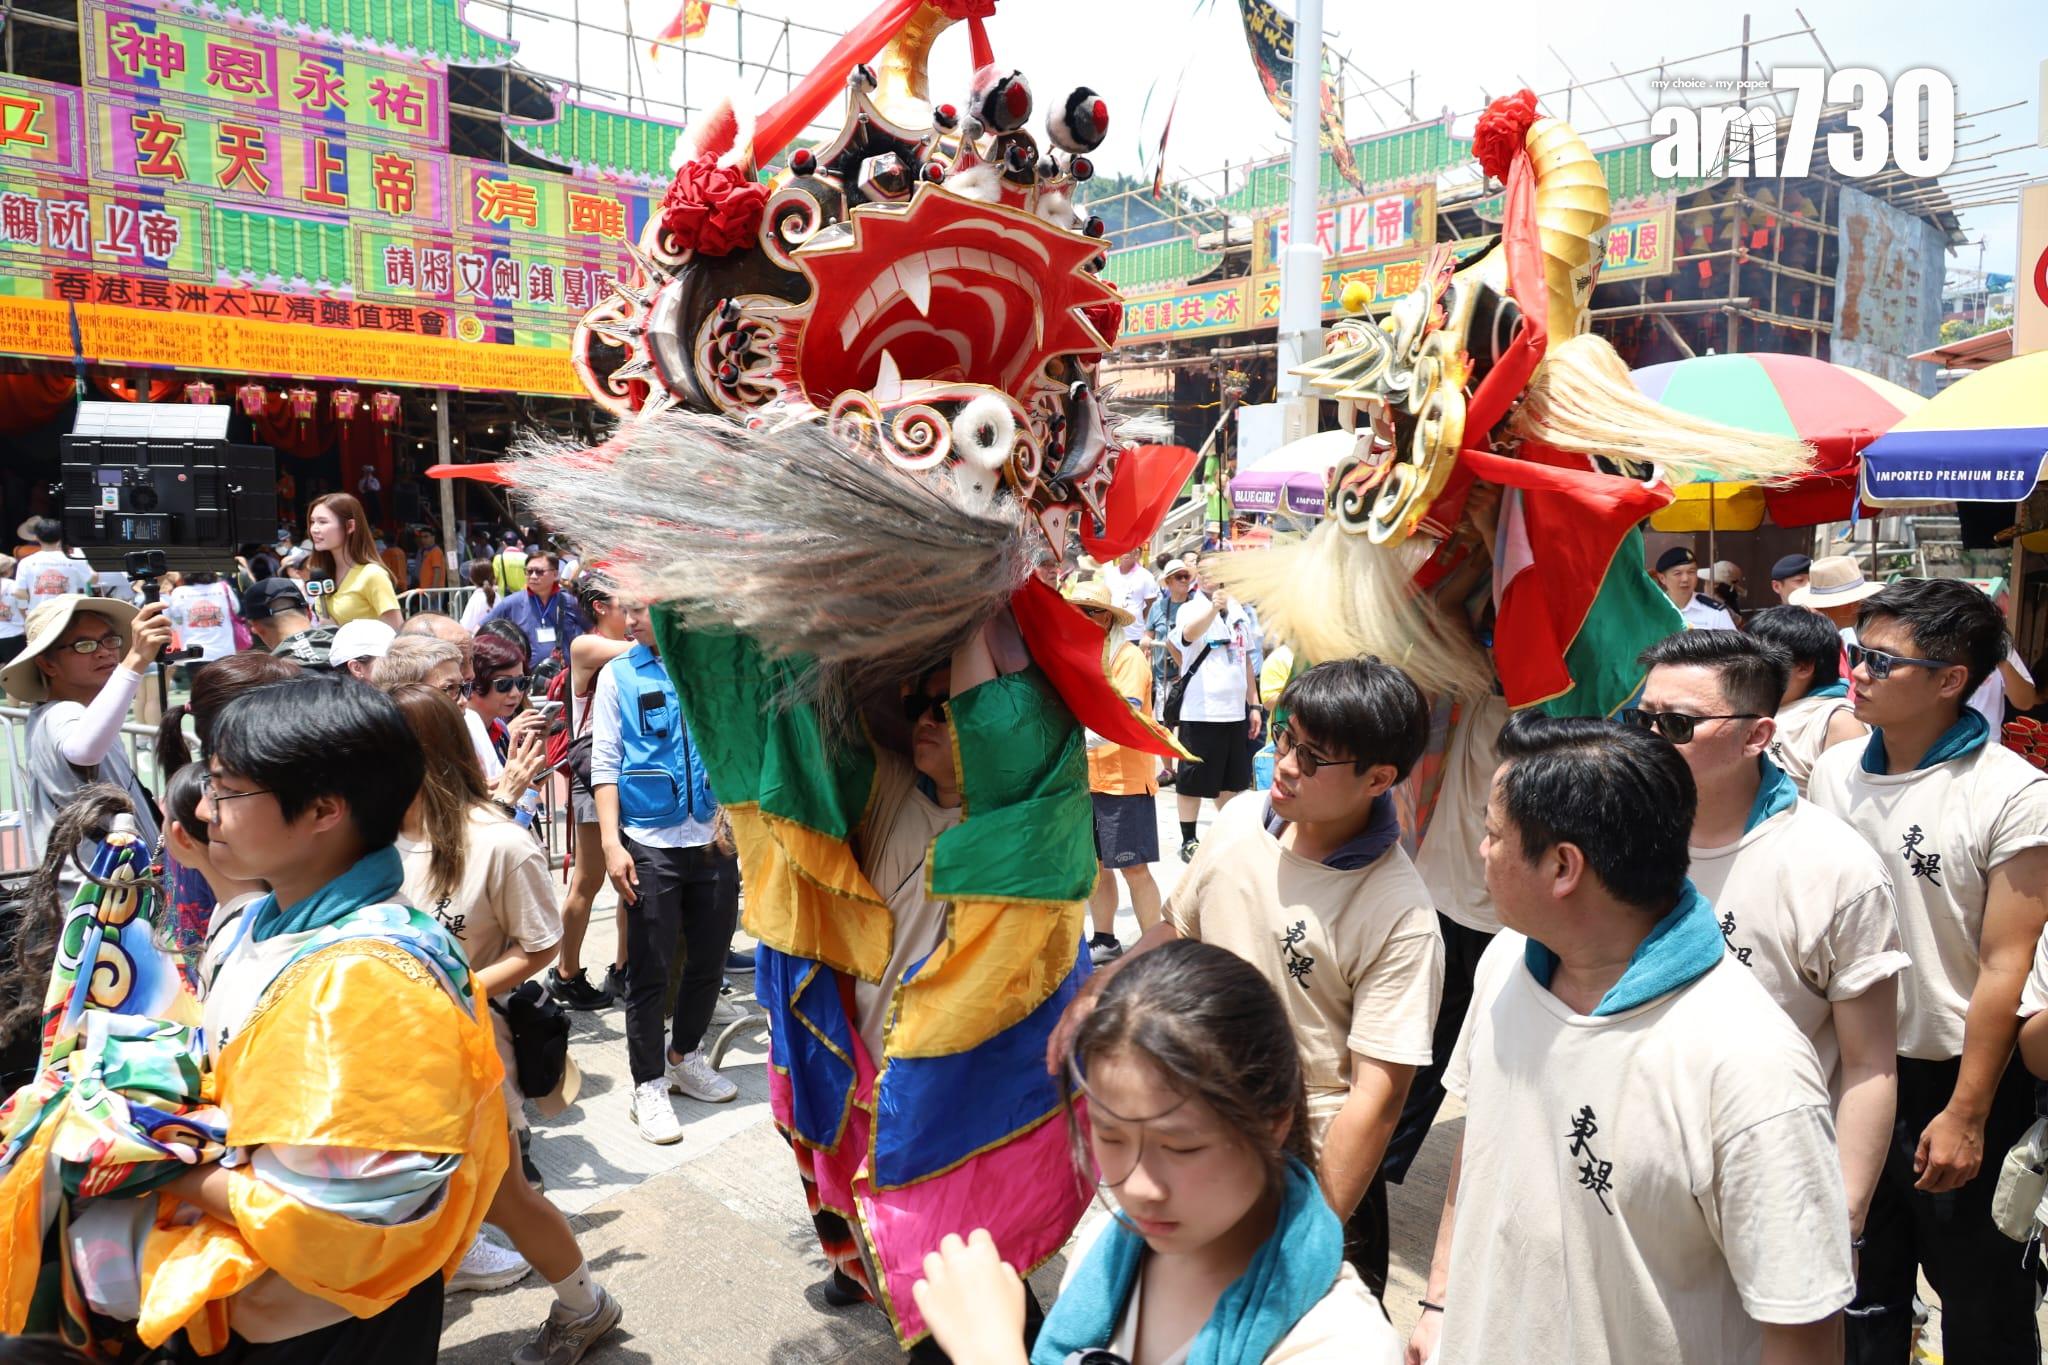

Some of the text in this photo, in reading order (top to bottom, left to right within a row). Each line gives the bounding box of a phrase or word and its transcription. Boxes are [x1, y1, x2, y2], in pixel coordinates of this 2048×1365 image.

[115, 25, 426, 128] 神恩永祐
[134, 112, 415, 216] 玄天上帝
[1607, 224, 1658, 266] 神恩
[1178, 293, 1241, 326] 共沐
[1876, 470, 2025, 482] IMPORTED PREMIUM BEER
